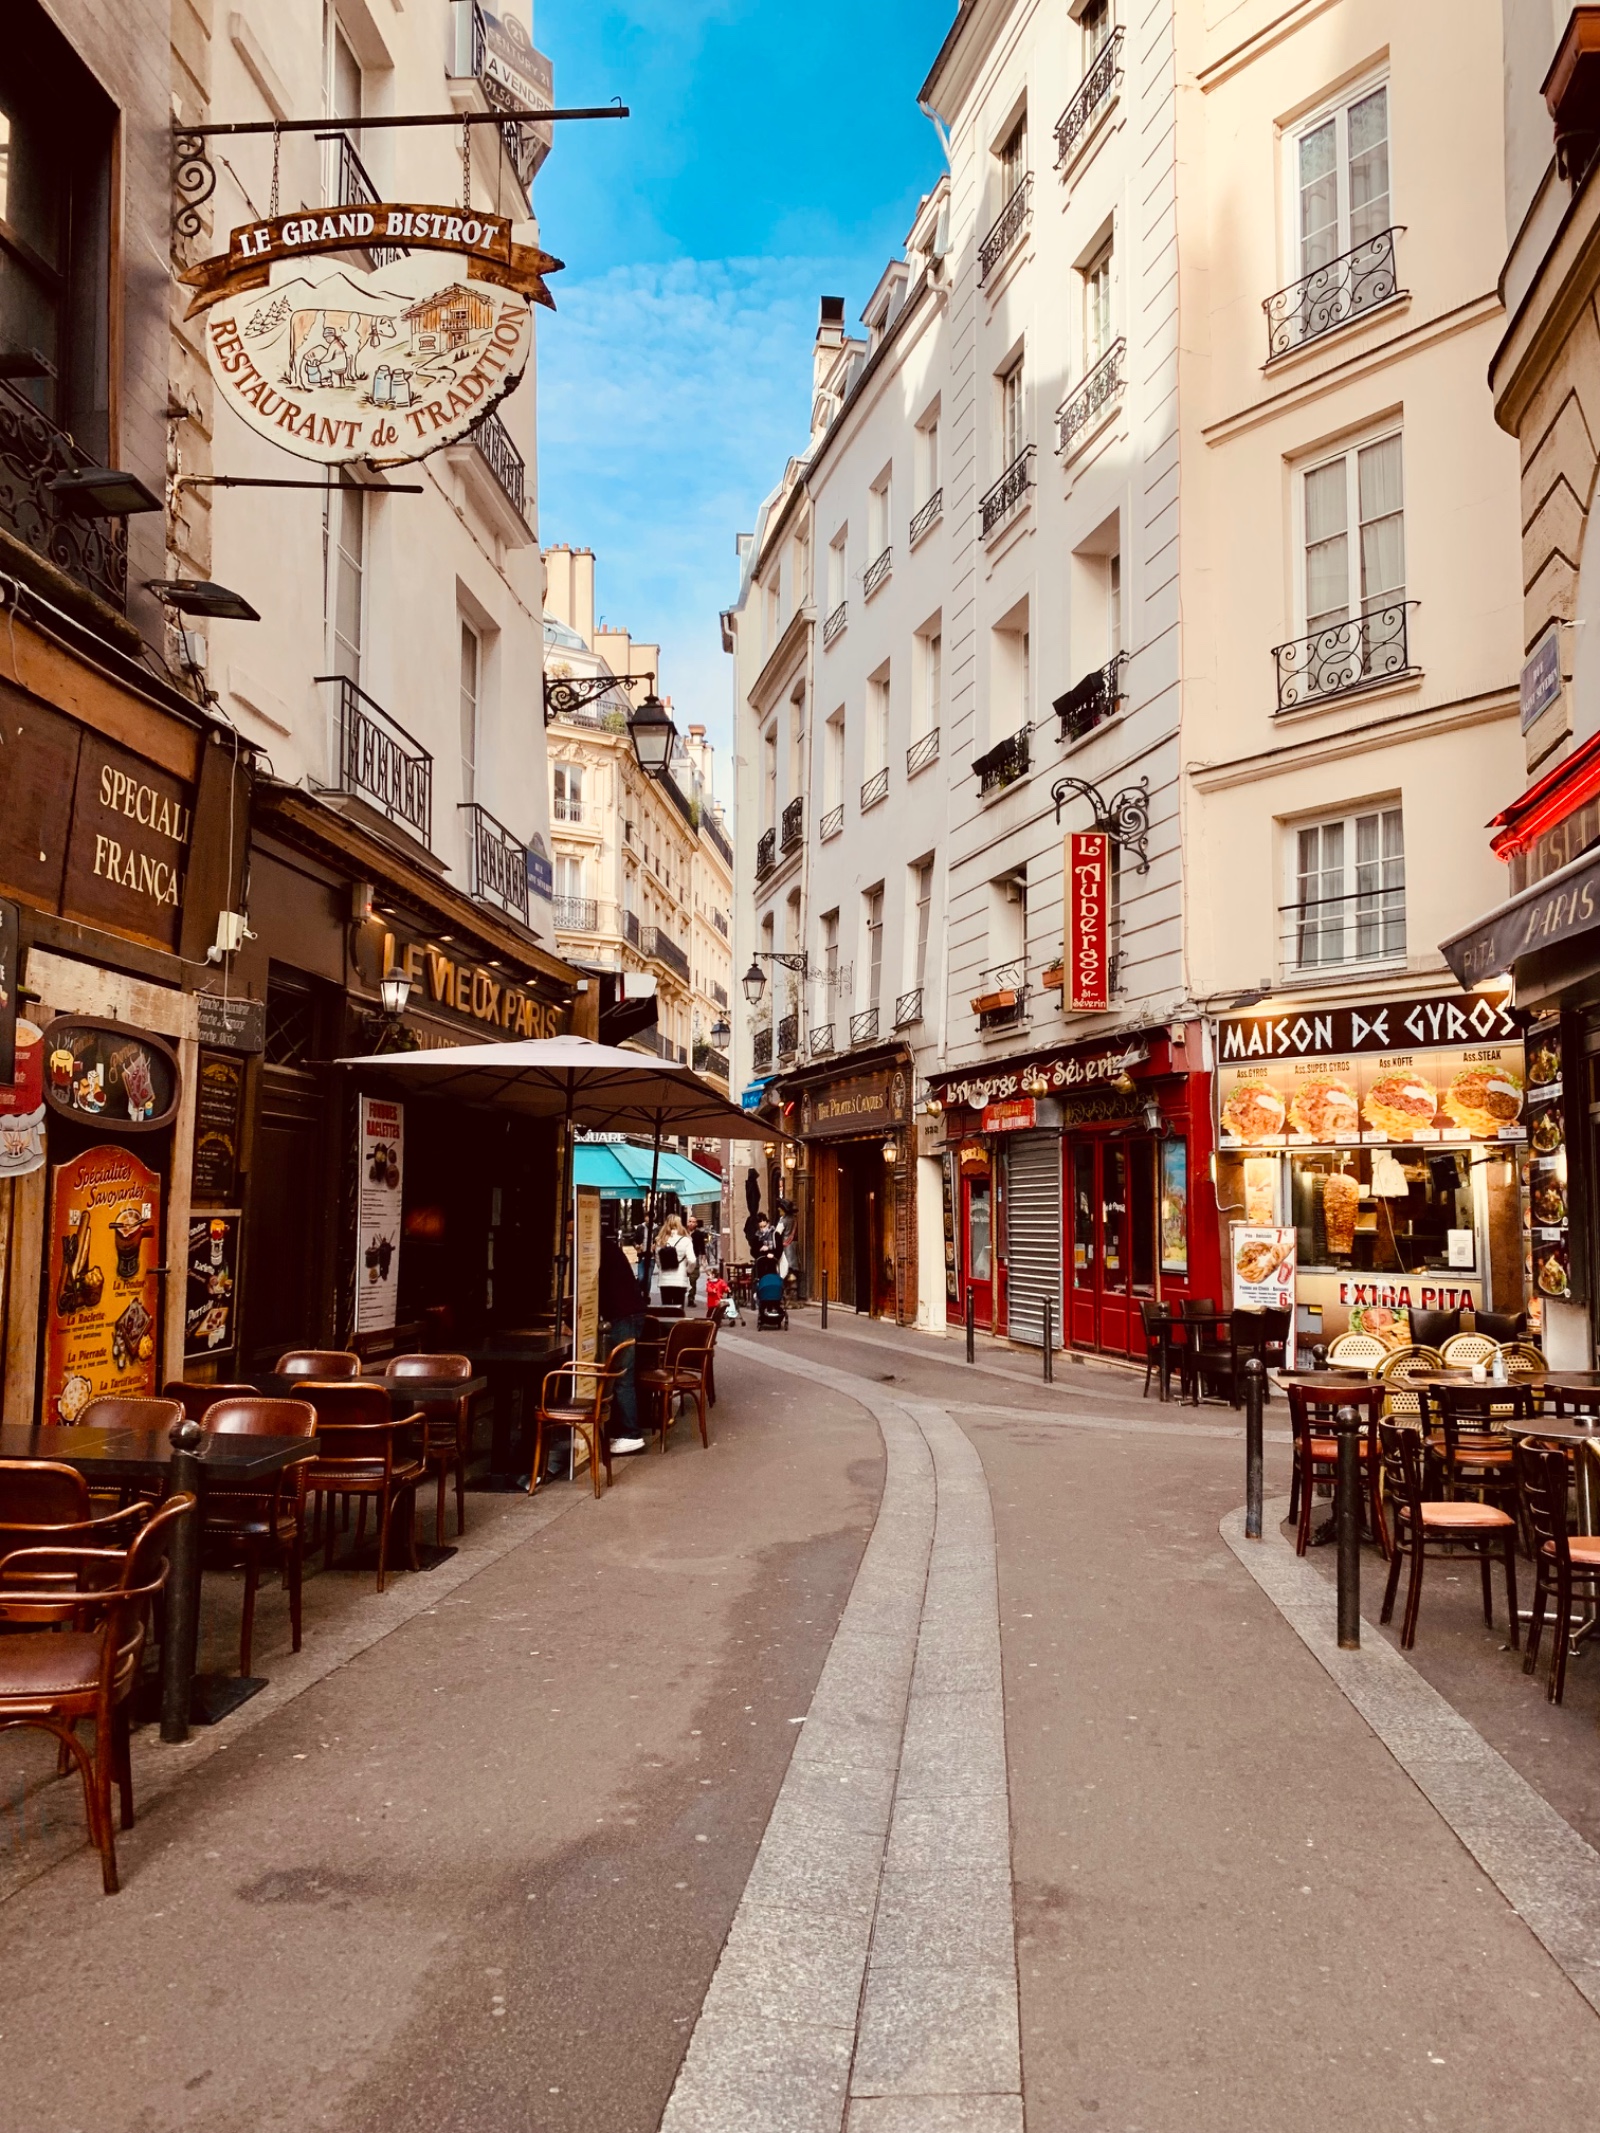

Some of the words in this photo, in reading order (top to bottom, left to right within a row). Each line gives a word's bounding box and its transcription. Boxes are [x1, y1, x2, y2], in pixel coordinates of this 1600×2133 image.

[487, 26, 538, 77] CENTURY
[488, 57, 499, 75] A
[239, 228, 271, 258] LE
[282, 213, 375, 247] GRAND
[386, 212, 499, 250] BISTROT
[210, 316, 363, 449] RESTAURANT
[370, 418, 400, 449] de
[405, 301, 528, 438] TRADITION
[1525, 879, 1595, 945] PARIS
[1463, 937, 1496, 979] PITA
[425, 950, 501, 1026] VIEUX
[501, 987, 557, 1039] PARIS
[1072, 997, 1106, 1009] Séverin
[1223, 1015, 1333, 1059] MAISON
[1351, 1007, 1391, 1049] DE
[1404, 998, 1516, 1042] GYROS
[1053, 1051, 1126, 1085] Séverin
[1328, 1060, 1351, 1073] GYROS
[1462, 1049, 1502, 1063] Ass.STEAK
[86, 1181, 146, 1210] Savoyardes
[1340, 1282, 1412, 1309] EXTRA
[1421, 1286, 1476, 1314] PITA
